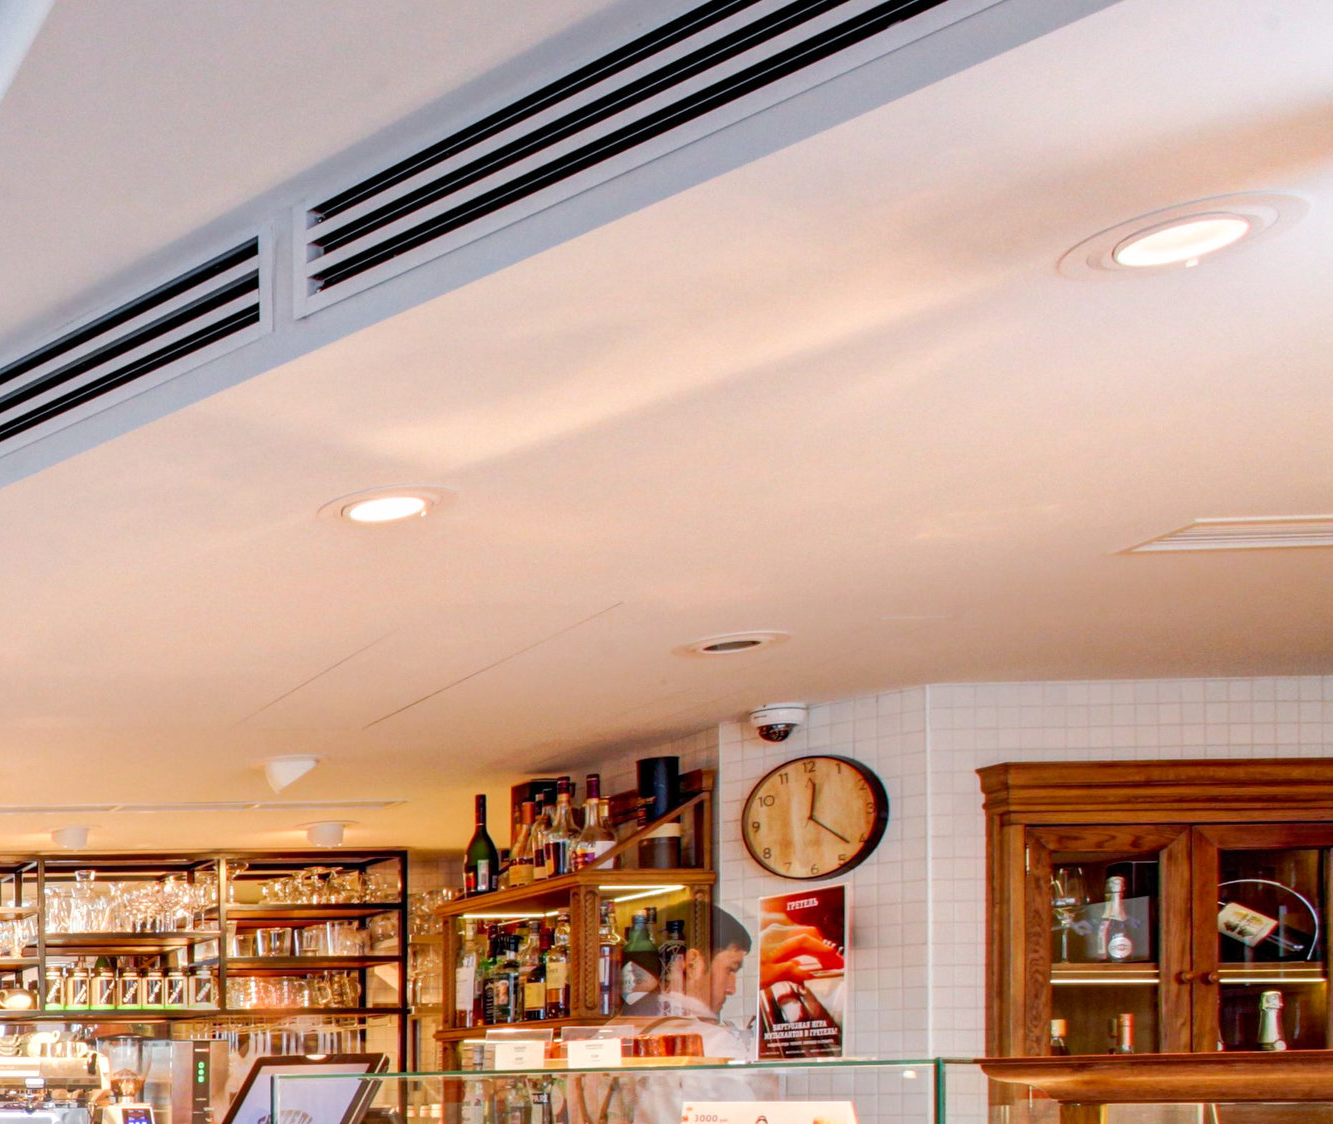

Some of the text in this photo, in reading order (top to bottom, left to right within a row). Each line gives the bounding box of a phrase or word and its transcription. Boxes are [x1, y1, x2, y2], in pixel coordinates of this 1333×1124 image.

[802, 760, 816, 773] 12
[835, 763, 842, 774] 1
[778, 773, 789, 785] 11
[758, 794, 775, 808] 10
[751, 821, 761, 833] 9
[763, 847, 772, 859] 8
[784, 862, 792, 873] 7
[811, 864, 820, 875] 6
